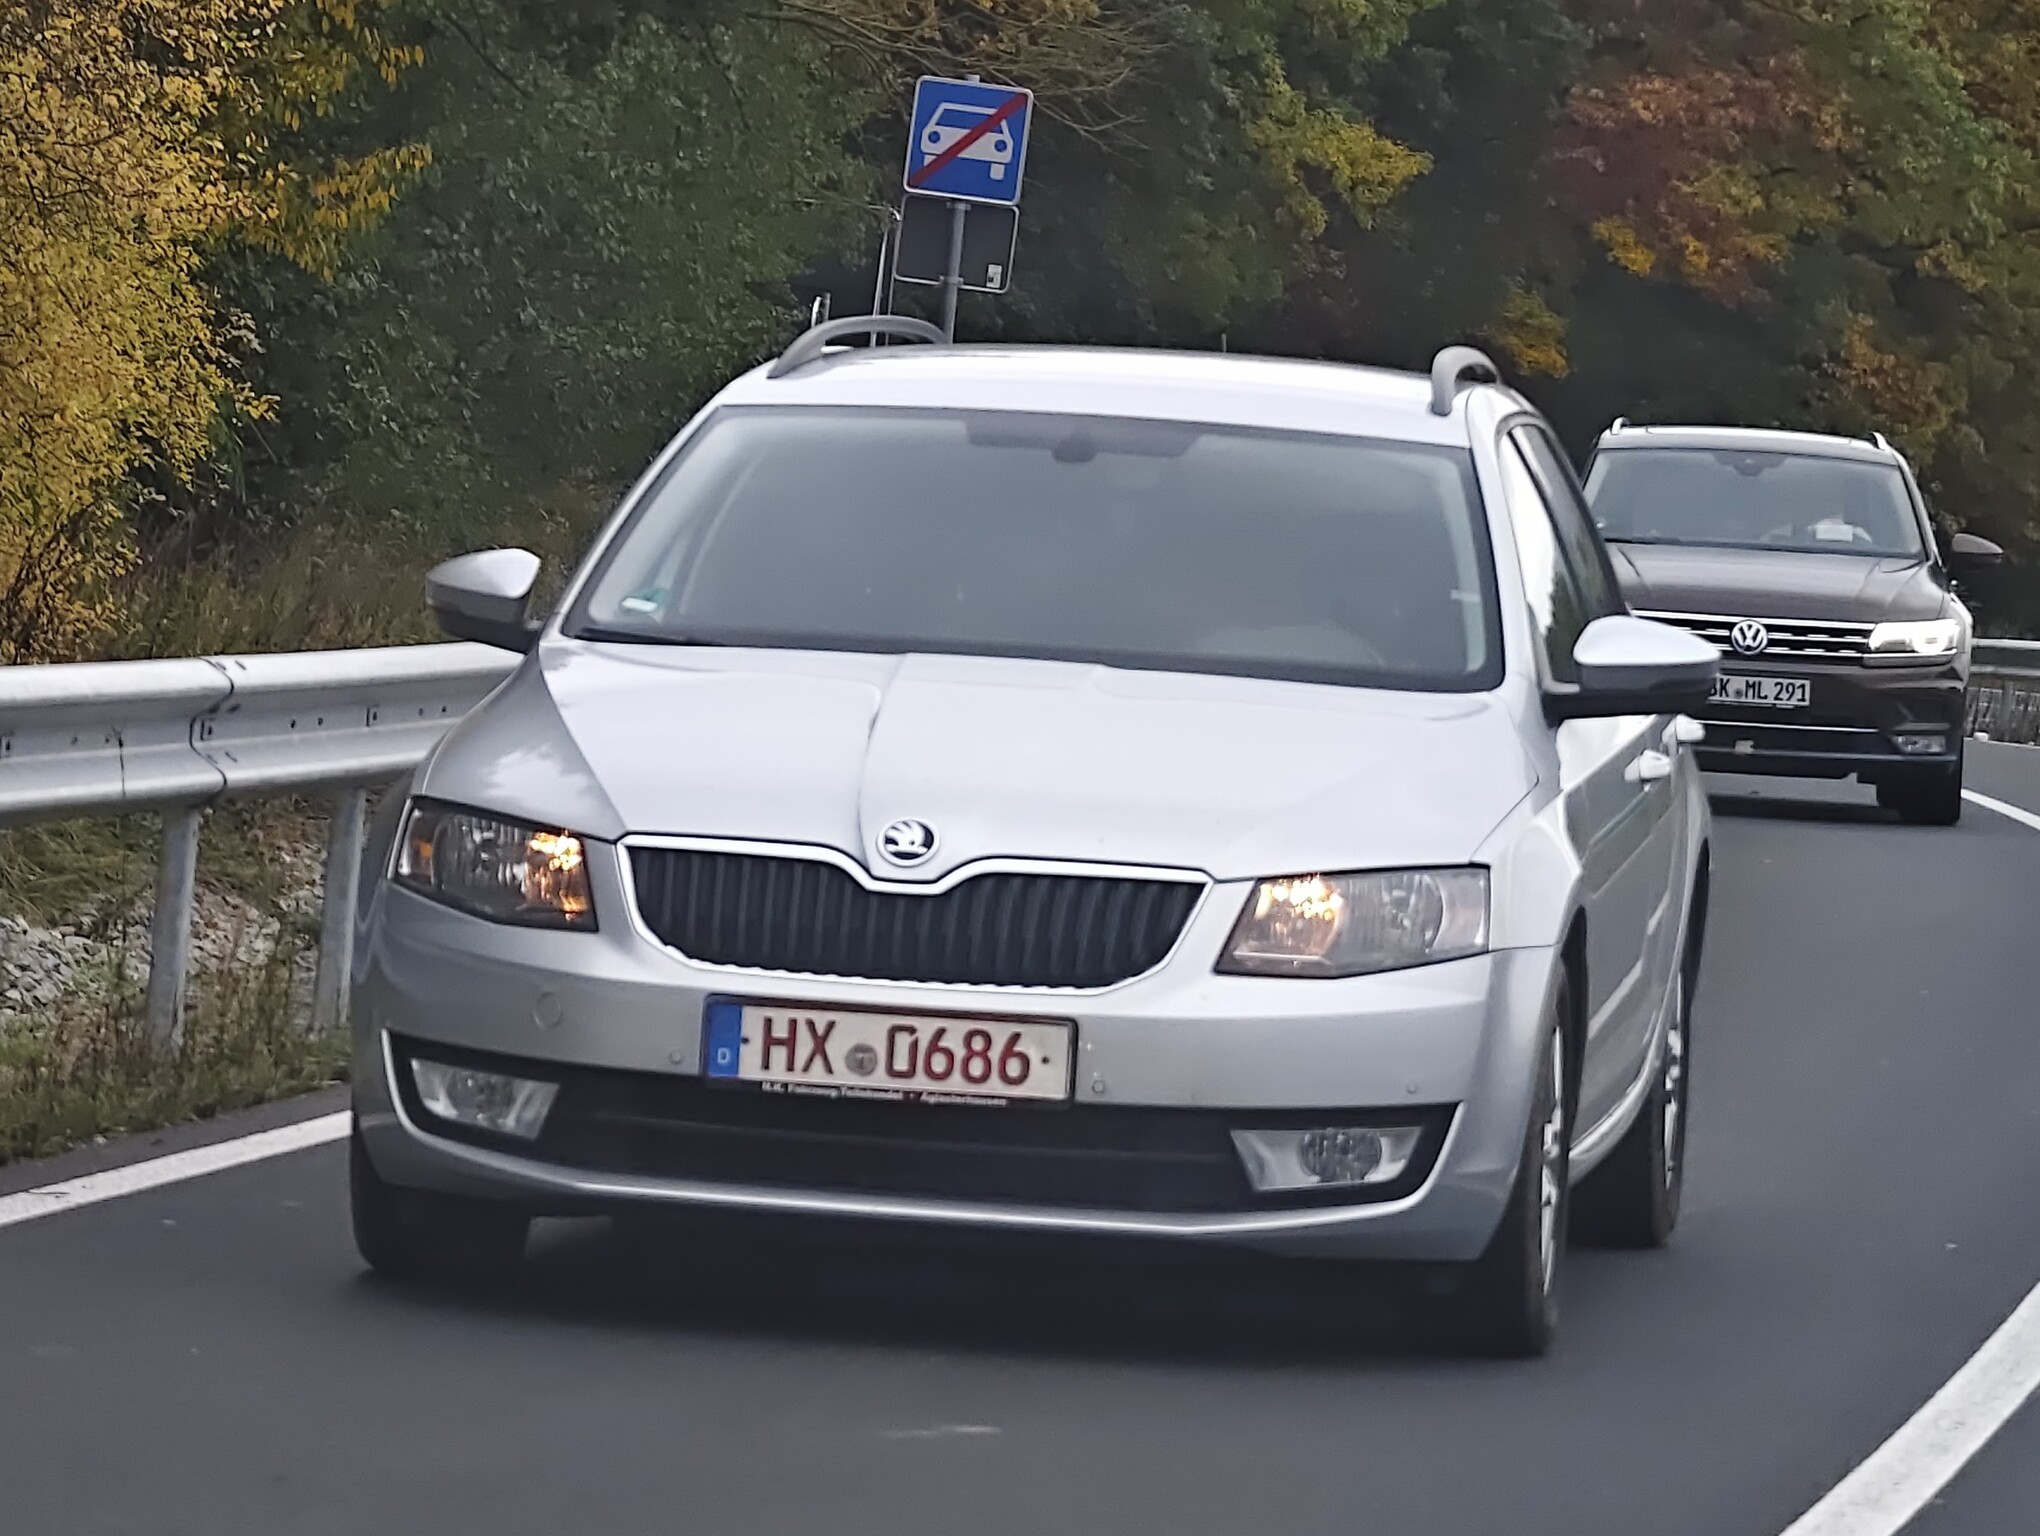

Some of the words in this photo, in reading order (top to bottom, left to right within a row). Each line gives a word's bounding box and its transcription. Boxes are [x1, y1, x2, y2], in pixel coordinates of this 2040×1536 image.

[1745, 680, 1768, 700] ML
[1773, 682, 1807, 702] 291
[718, 1048, 732, 1064] D
[761, 1017, 836, 1075] HX
[886, 1024, 1031, 1085] 0686
